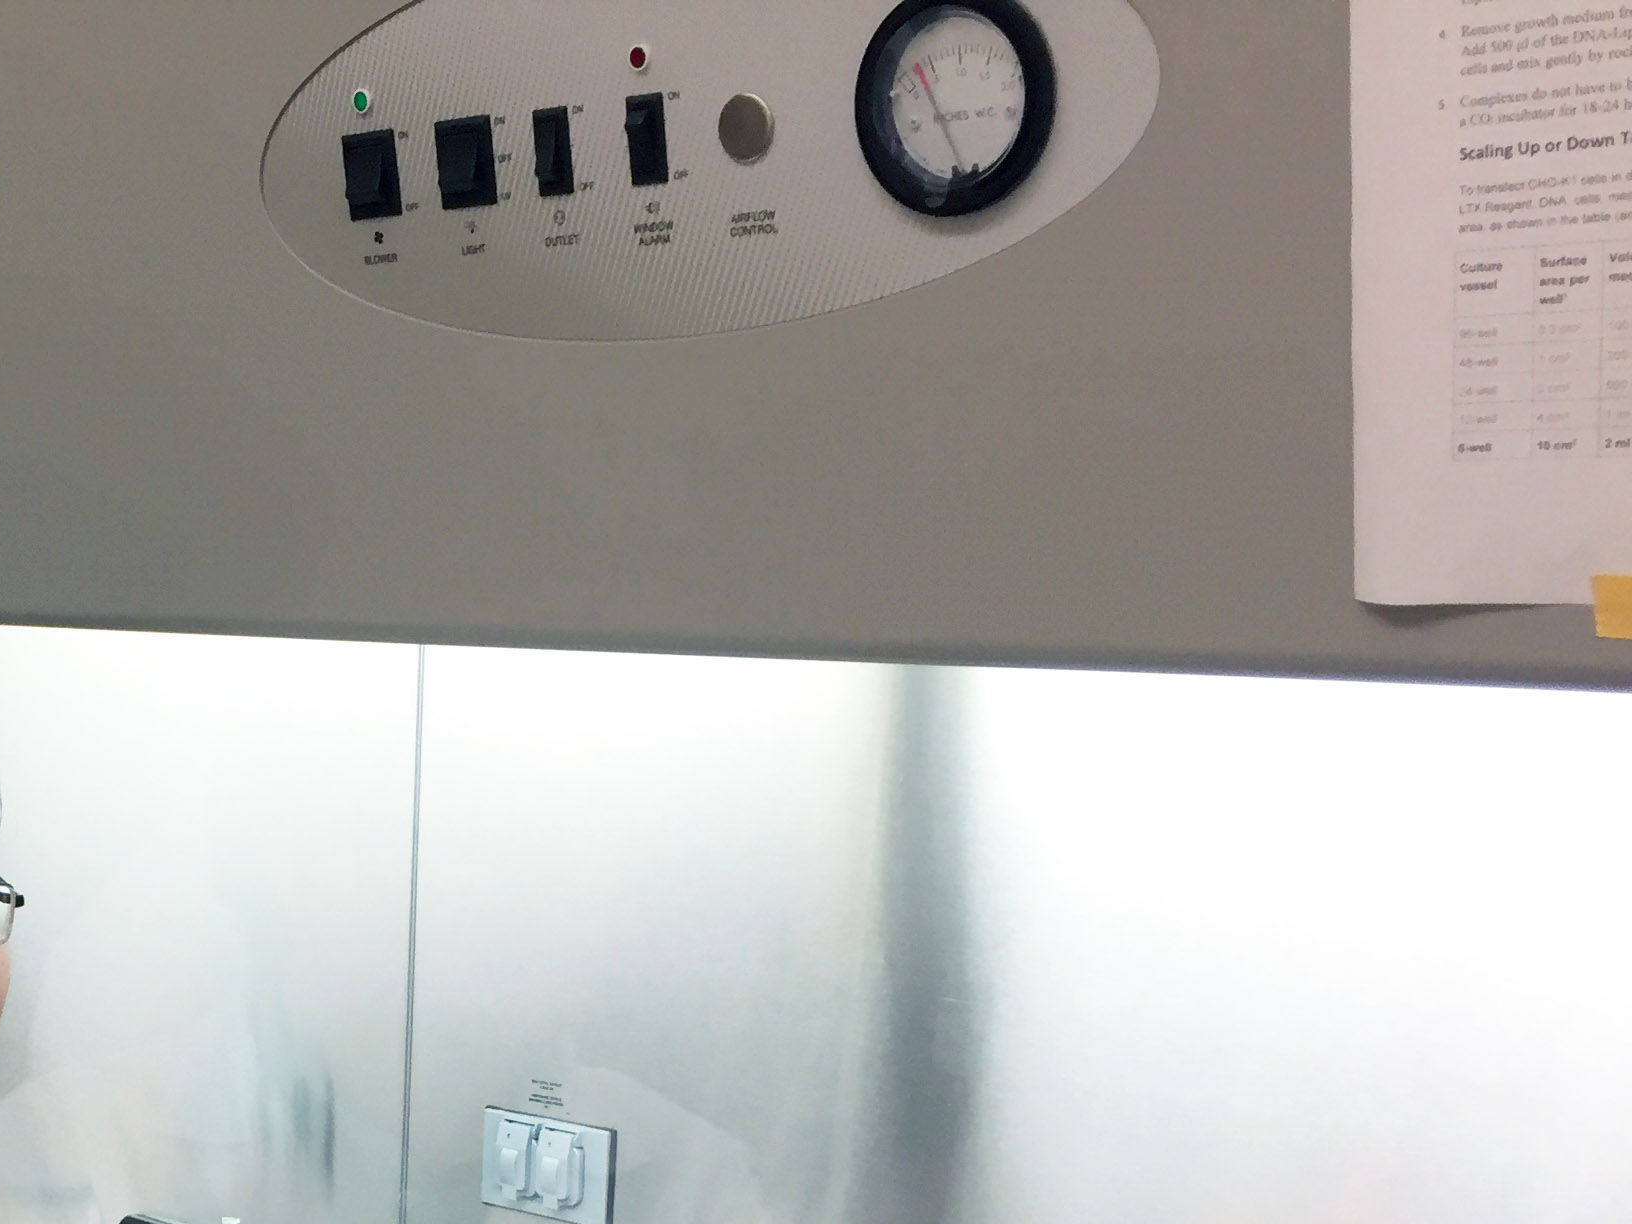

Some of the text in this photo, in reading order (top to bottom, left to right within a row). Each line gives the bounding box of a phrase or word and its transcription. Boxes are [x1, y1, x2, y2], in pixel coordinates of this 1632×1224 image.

[1461, 23, 1511, 37] Remove
[1514, 14, 1558, 34] growth
[1563, 9, 1614, 25] medium
[1461, 42, 1487, 56] Add
[1533, 35, 1547, 49] of
[1550, 33, 1569, 46] the
[1459, 62, 1488, 76] cells
[1491, 59, 1513, 73] and
[1517, 56, 1540, 70] mix
[1545, 52, 1582, 70] gently
[1588, 49, 1603, 63] by
[669, 90, 680, 100] ON
[1460, 92, 1528, 107] Complexes
[1531, 88, 1547, 100] do
[1551, 86, 1571, 98] not
[1575, 81, 1605, 95] have
[1609, 80, 1622, 91] to
[572, 104, 584, 115] ON
[1497, 106, 1556, 124] incubator
[1559, 103, 1577, 116] for
[1583, 100, 1619, 114] 18-24
[494, 115, 506, 126] ON
[397, 129, 409, 140] ON
[1459, 143, 1513, 161] Scaling
[1518, 141, 1540, 157] Up
[1545, 140, 1563, 153] or
[1567, 135, 1615, 151] Down
[497, 152, 512, 164] OFF
[673, 169, 689, 181] OFF
[579, 181, 594, 192] OFF
[1459, 184, 1474, 196] To
[1477, 181, 1525, 195] transfect
[1581, 174, 1608, 186] cells
[1612, 172, 1622, 181] in
[405, 202, 419, 213] OFF
[1459, 203, 1480, 215] LTX
[731, 209, 776, 225] AIRFLOW
[1489, 221, 1503, 232] as
[1506, 217, 1543, 231] shown
[1547, 216, 1557, 226] in
[1561, 213, 1579, 226] the
[1582, 211, 1612, 224] table
[633, 219, 674, 234] WINDOW
[730, 223, 779, 238] CONTROL
[544, 234, 580, 248] OUTLET
[638, 233, 671, 247] ALARM
[461, 243, 486, 256] LIGHT
[364, 253, 398, 266] BLOWER
[1540, 256, 1587, 268] Surface
[1460, 262, 1504, 274] Culture
[1460, 279, 1498, 292] vessel
[1539, 275, 1590, 287] area per
[1457, 442, 1492, 453] 6-well
[1537, 440, 1551, 450] 10
[1604, 437, 1631, 449] 2 ml
